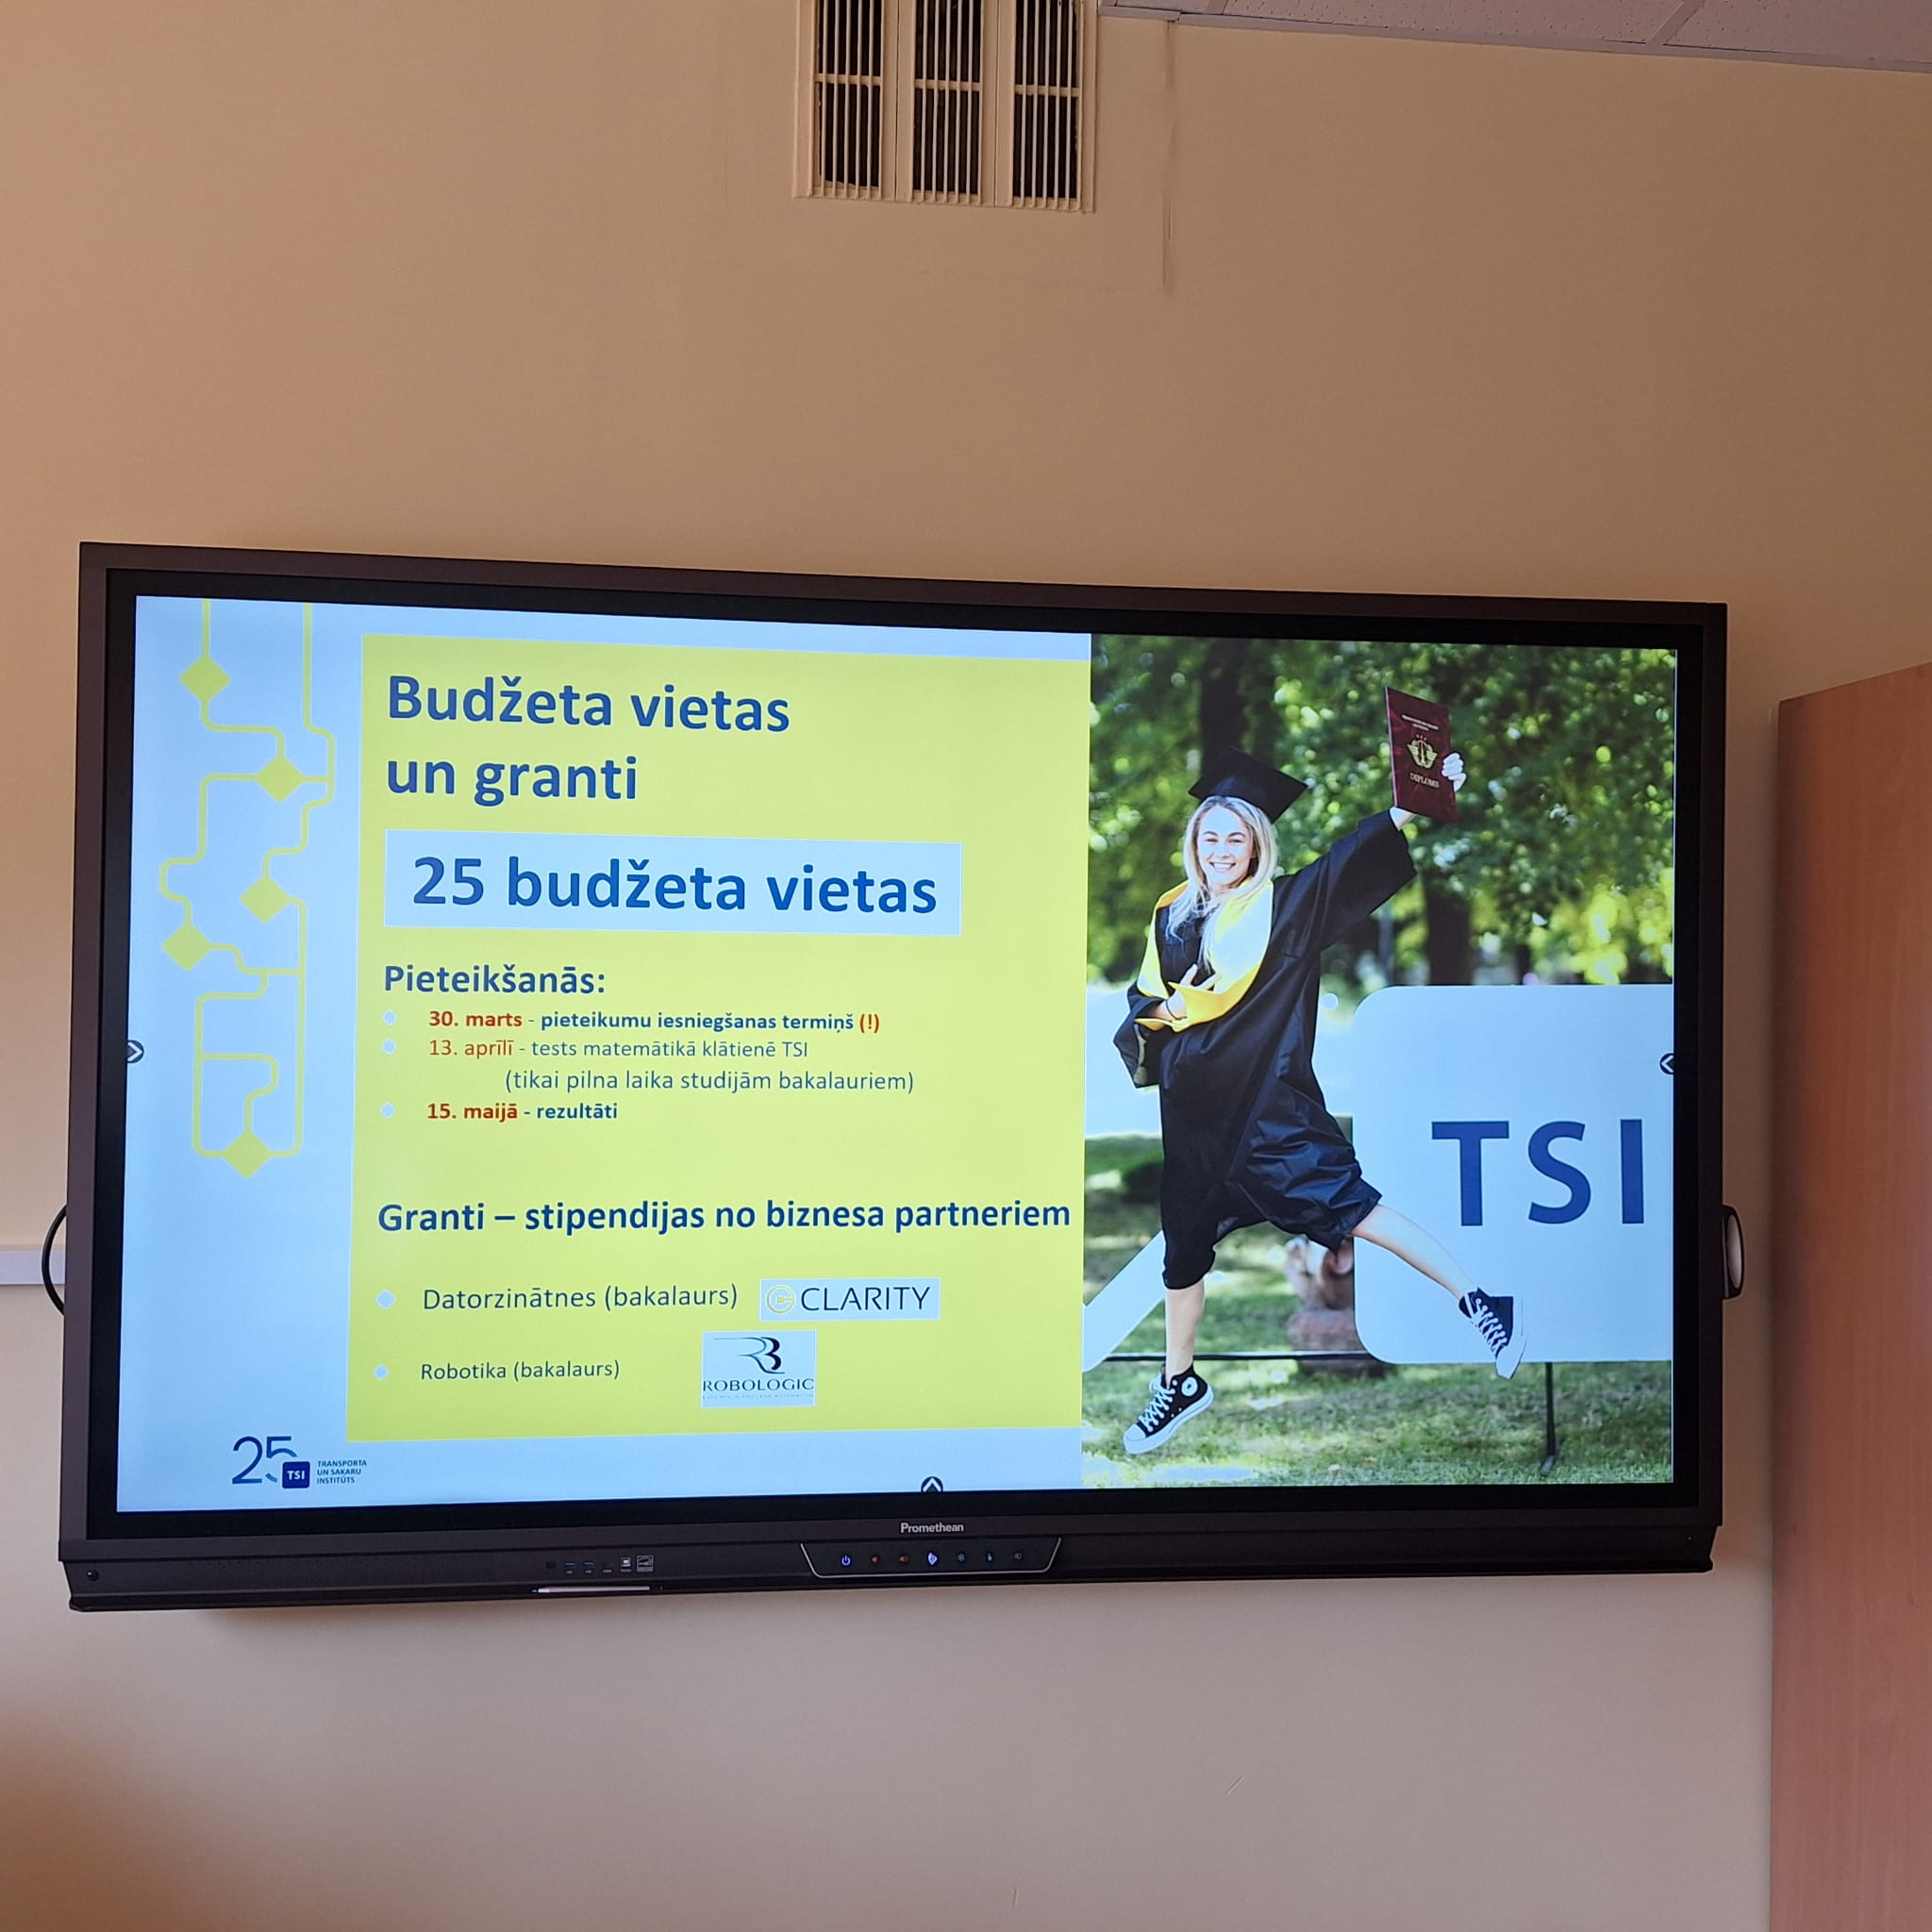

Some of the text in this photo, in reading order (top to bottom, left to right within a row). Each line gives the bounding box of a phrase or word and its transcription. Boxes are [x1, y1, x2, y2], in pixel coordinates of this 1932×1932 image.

[388, 675, 790, 732] Budžeta vietas
[388, 757, 638, 806] un granti
[412, 856, 938, 914] 25 budžeta vietas
[384, 964, 606, 993] Pieteikšanās:
[429, 1011, 458, 1026] 30.
[466, 1012, 523, 1026] marts
[541, 1012, 651, 1030] pieteikumu
[658, 1012, 776, 1032] iesniegšanas
[783, 1014, 854, 1033] termiņš
[859, 1013, 879, 1033] (!)
[429, 1041, 458, 1056] 13.
[465, 1040, 514, 1058] aprīlī
[532, 1041, 576, 1056] tests
[584, 1041, 695, 1057] matemātikā
[703, 1041, 775, 1057] klātienē
[782, 1042, 808, 1057] TSI
[506, 1070, 913, 1094] (tikai pilna laika studijām bakalauriem)
[428, 1104, 457, 1119] 15.
[464, 1103, 518, 1123] maijā
[538, 1103, 617, 1119] rezultāti
[1431, 1119, 1644, 1226] TSI
[378, 1203, 485, 1232] Granti
[525, 1200, 705, 1235] stipendijas
[715, 1207, 756, 1228] no
[766, 1200, 885, 1228] biznesa
[894, 1200, 1071, 1233] partneriem
[423, 1284, 738, 1312] Datorzinātnes (bakalaurs)
[801, 1286, 929, 1311] CLARITY
[421, 1359, 620, 1381] Robotika (bakalaurs)
[703, 1378, 814, 1391] ROBOLOGIC
[287, 1471, 305, 1480] TSI
[900, 1522, 964, 1533] Promethean
